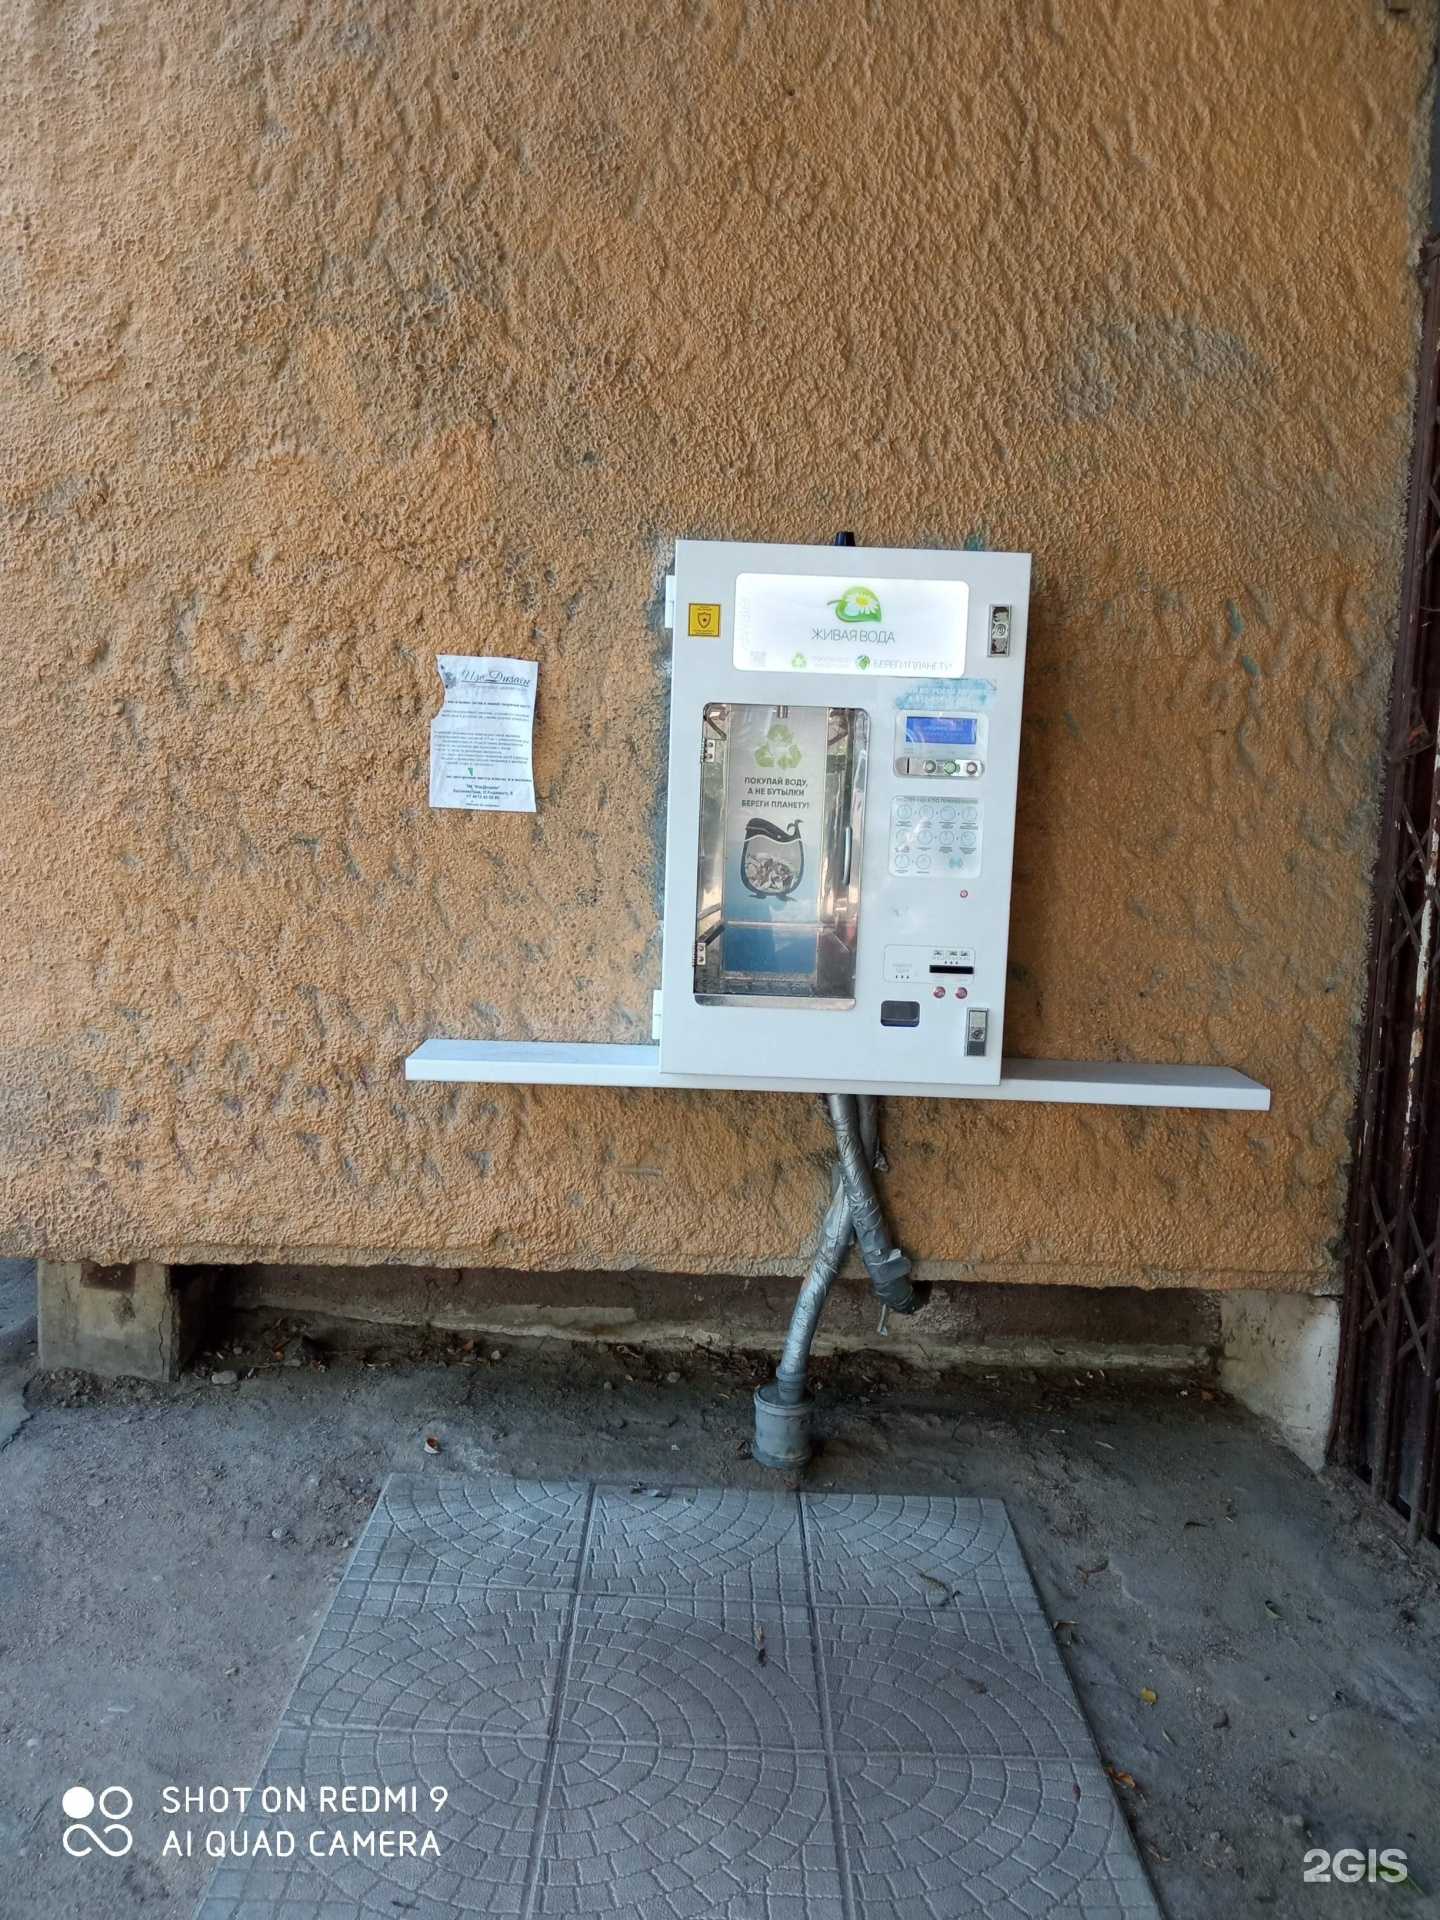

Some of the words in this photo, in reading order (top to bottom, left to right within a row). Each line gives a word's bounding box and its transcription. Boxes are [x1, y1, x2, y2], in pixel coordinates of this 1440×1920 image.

[812, 628, 858, 641] ЖИВАЯ
[859, 630, 896, 645] ВОДА
[744, 776, 783, 786] ПОКУПАЙ
[784, 778, 809, 788] ВОДУ,
[747, 787, 754, 795] А
[766, 788, 805, 797] БУТЫЛКИ
[741, 799, 770, 808] БЕРЕГИ
[771, 800, 810, 809] ПЛАНЕТУ!
